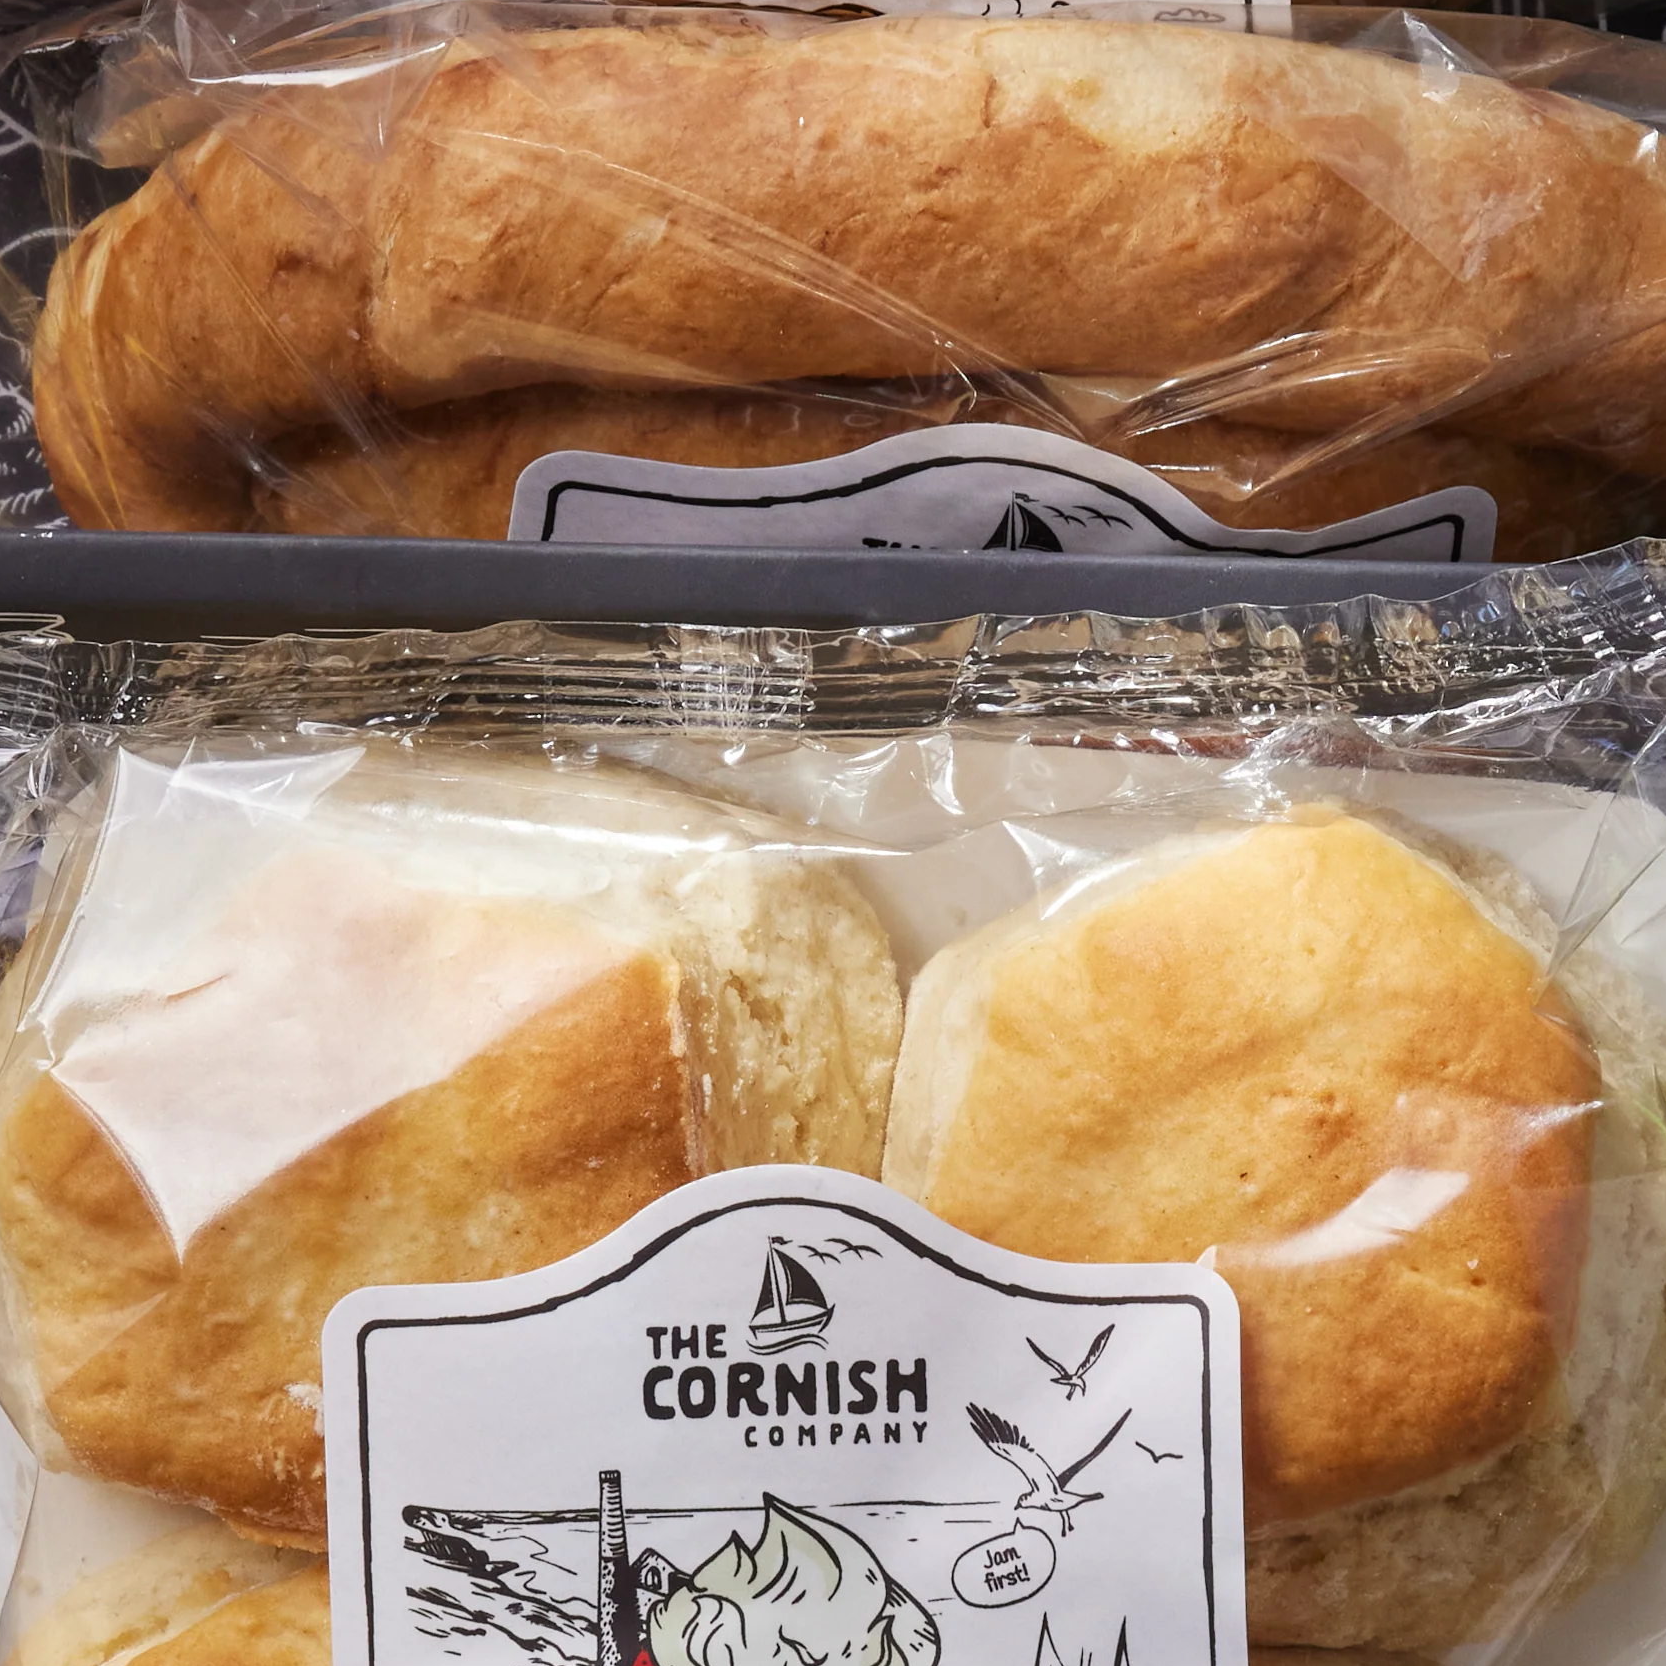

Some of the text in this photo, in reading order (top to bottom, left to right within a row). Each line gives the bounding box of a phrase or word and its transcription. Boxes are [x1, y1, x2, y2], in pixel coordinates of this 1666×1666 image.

[646, 1326, 727, 1359] THE
[642, 1358, 929, 1420] CORNISH
[744, 1421, 930, 1450] COMPANY
[984, 1547, 1021, 1569] Jam
[984, 1562, 1030, 1593] first!
